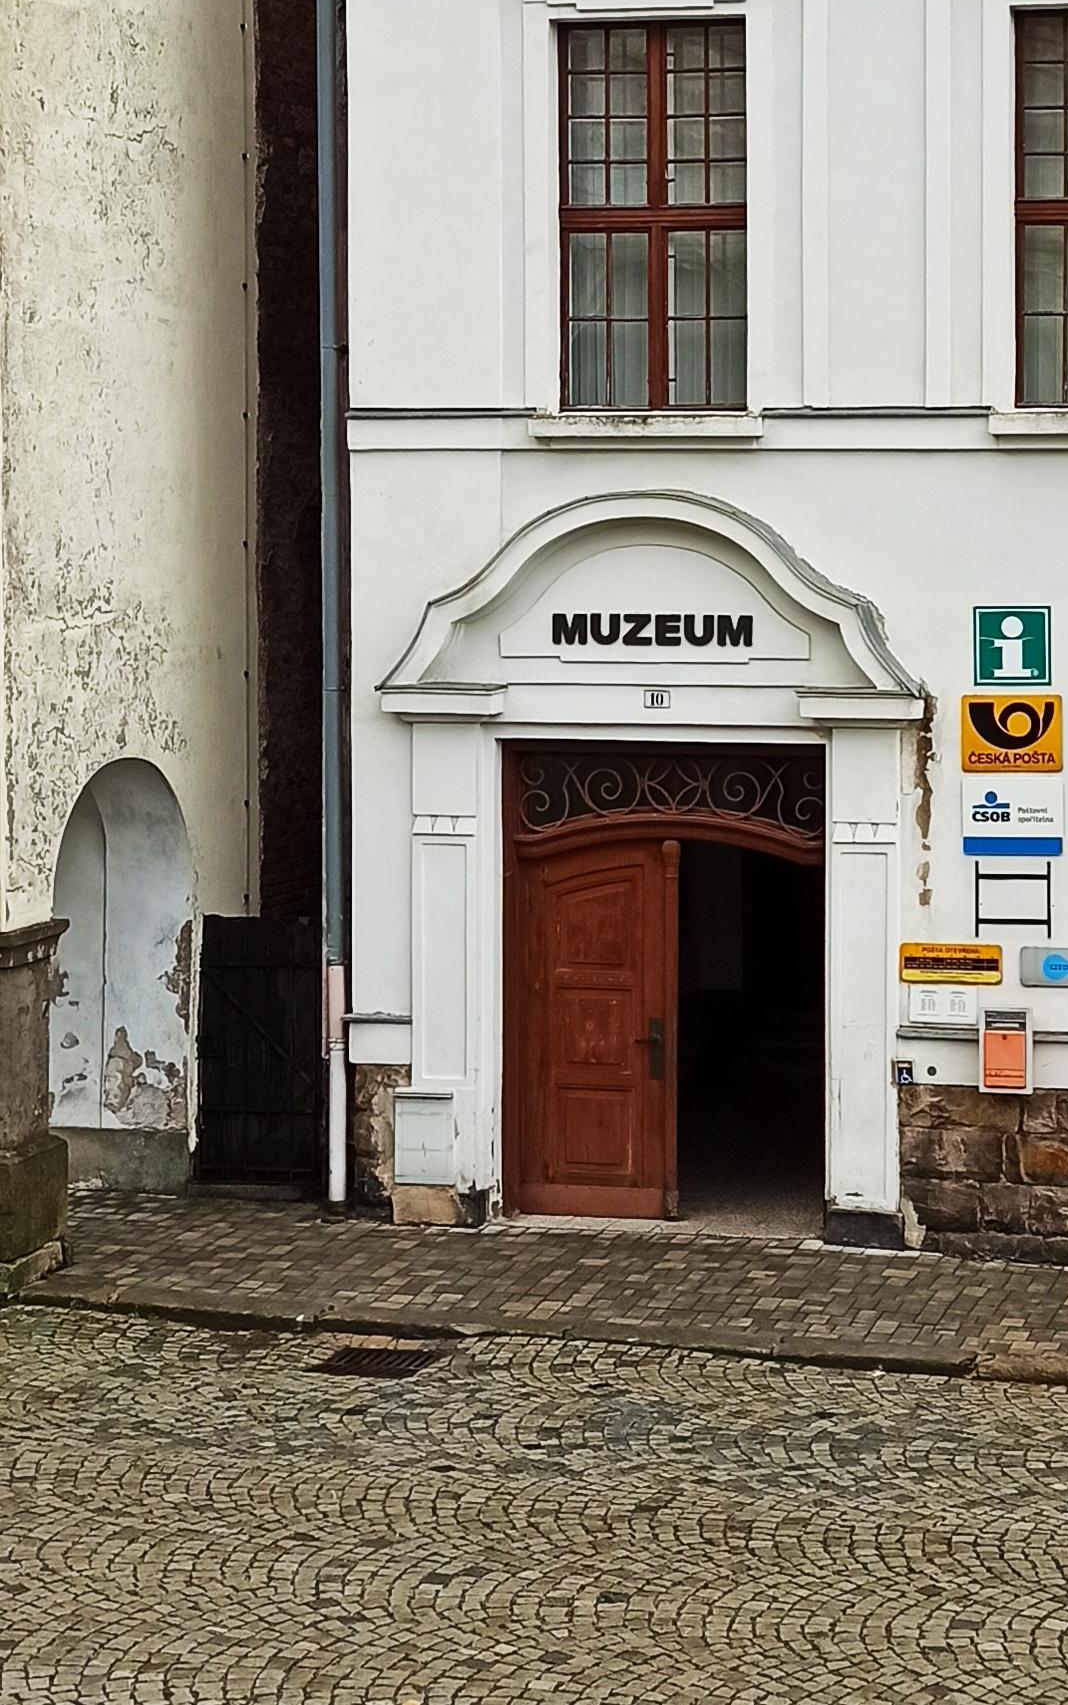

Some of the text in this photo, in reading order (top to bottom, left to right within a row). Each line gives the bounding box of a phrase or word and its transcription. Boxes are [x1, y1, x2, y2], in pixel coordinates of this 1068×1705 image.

[552, 612, 753, 647] MUZEUM
[649, 692, 664, 706] 10
[968, 751, 1056, 765] ČESKÁ POŠTA
[971, 810, 1011, 823] ČSOB
